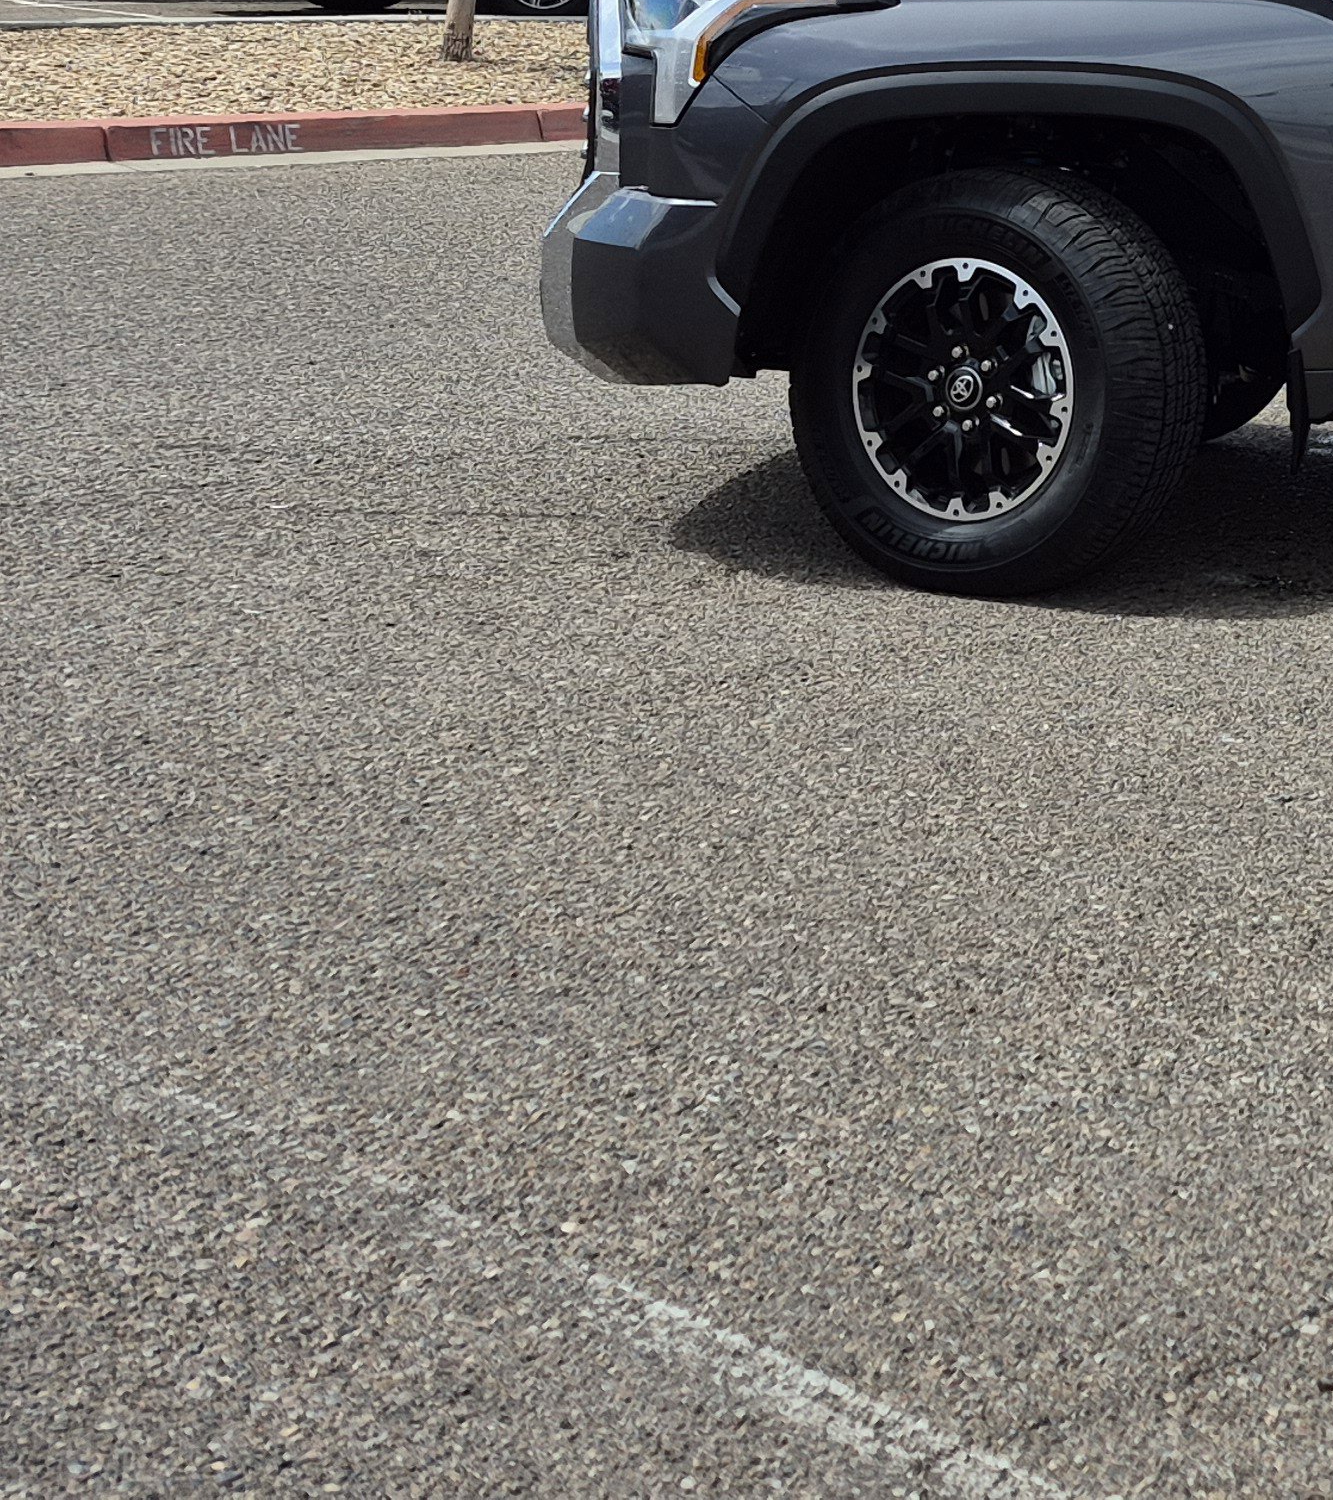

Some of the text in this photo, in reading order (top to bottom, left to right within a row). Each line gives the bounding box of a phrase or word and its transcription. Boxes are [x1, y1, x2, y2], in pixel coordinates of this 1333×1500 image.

[151, 123, 303, 156] FIRE LANE
[857, 509, 982, 561] MICHELIN
